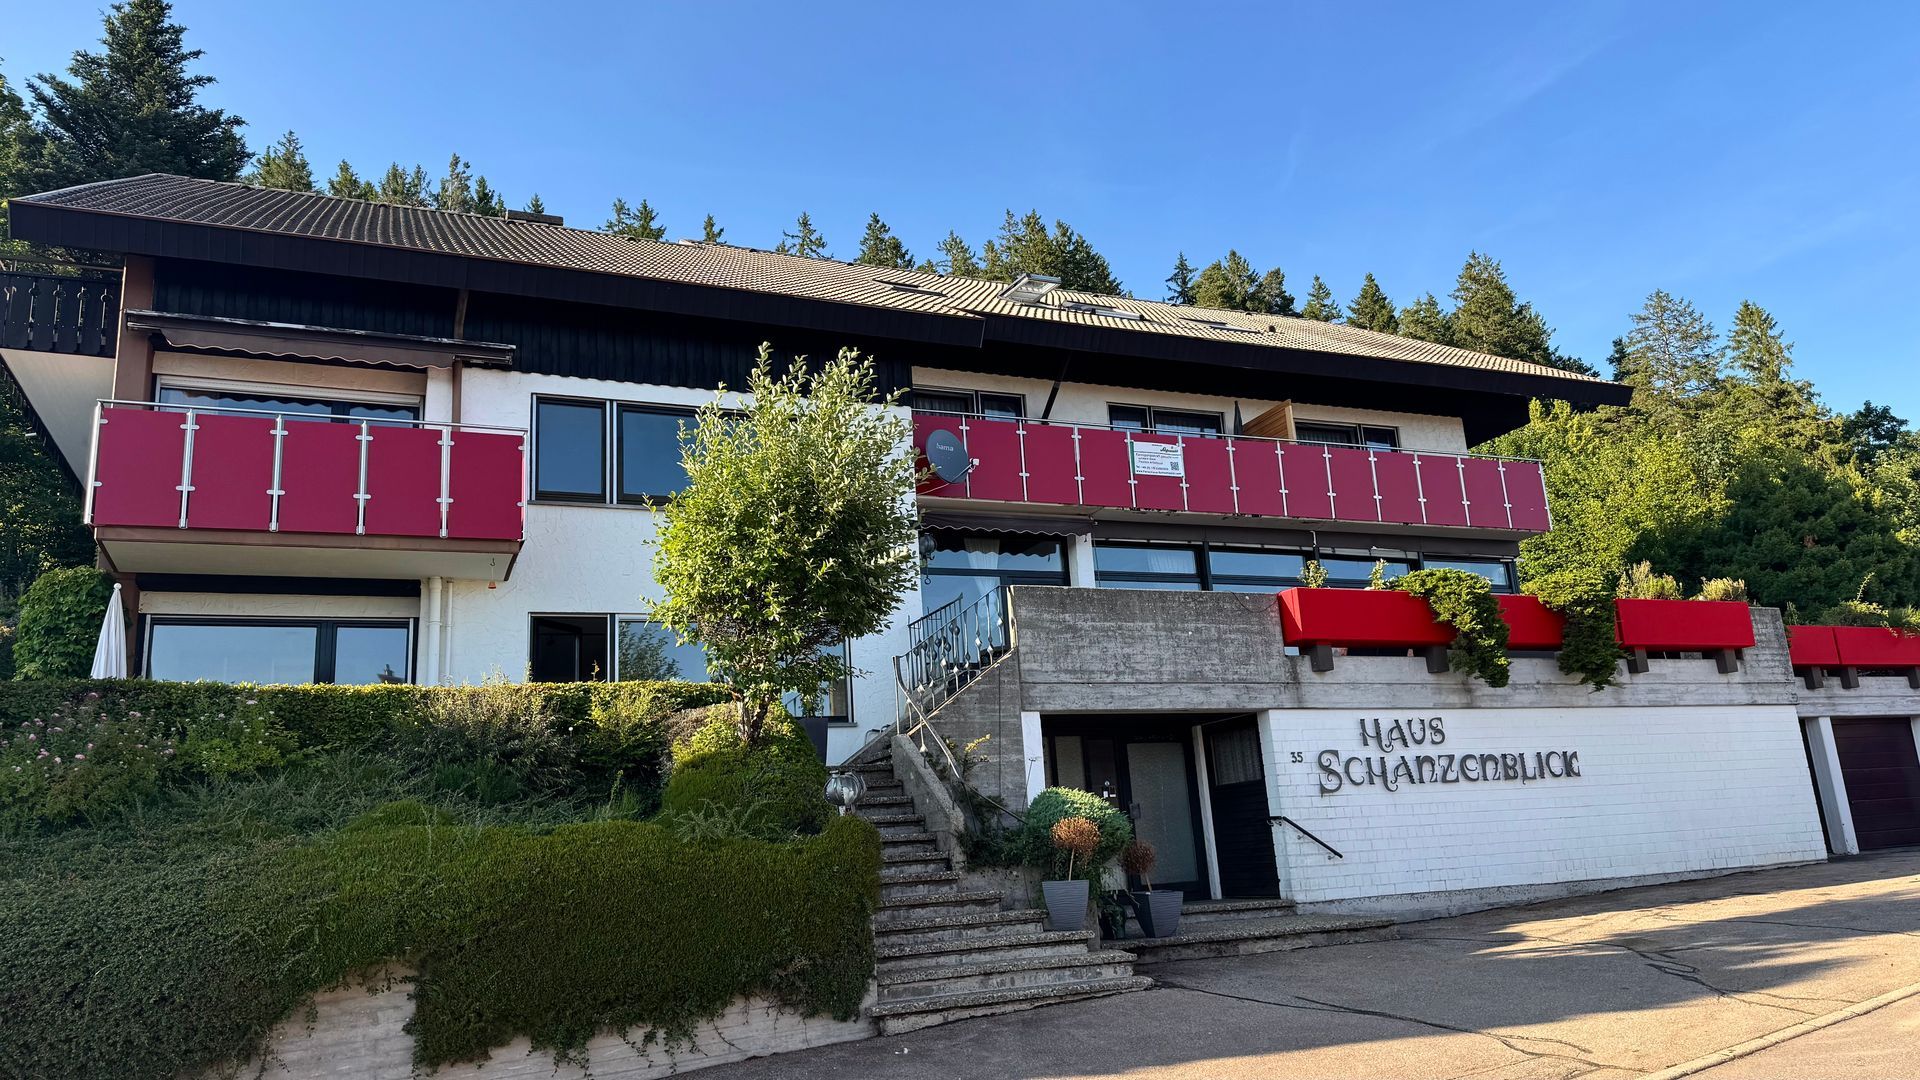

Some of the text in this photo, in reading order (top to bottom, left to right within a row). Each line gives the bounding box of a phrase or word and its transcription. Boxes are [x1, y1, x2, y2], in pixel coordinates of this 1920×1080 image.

[936, 442, 954, 452] hama
[1359, 717, 1446, 753] HAUS
[1290, 751, 1303, 763] 35
